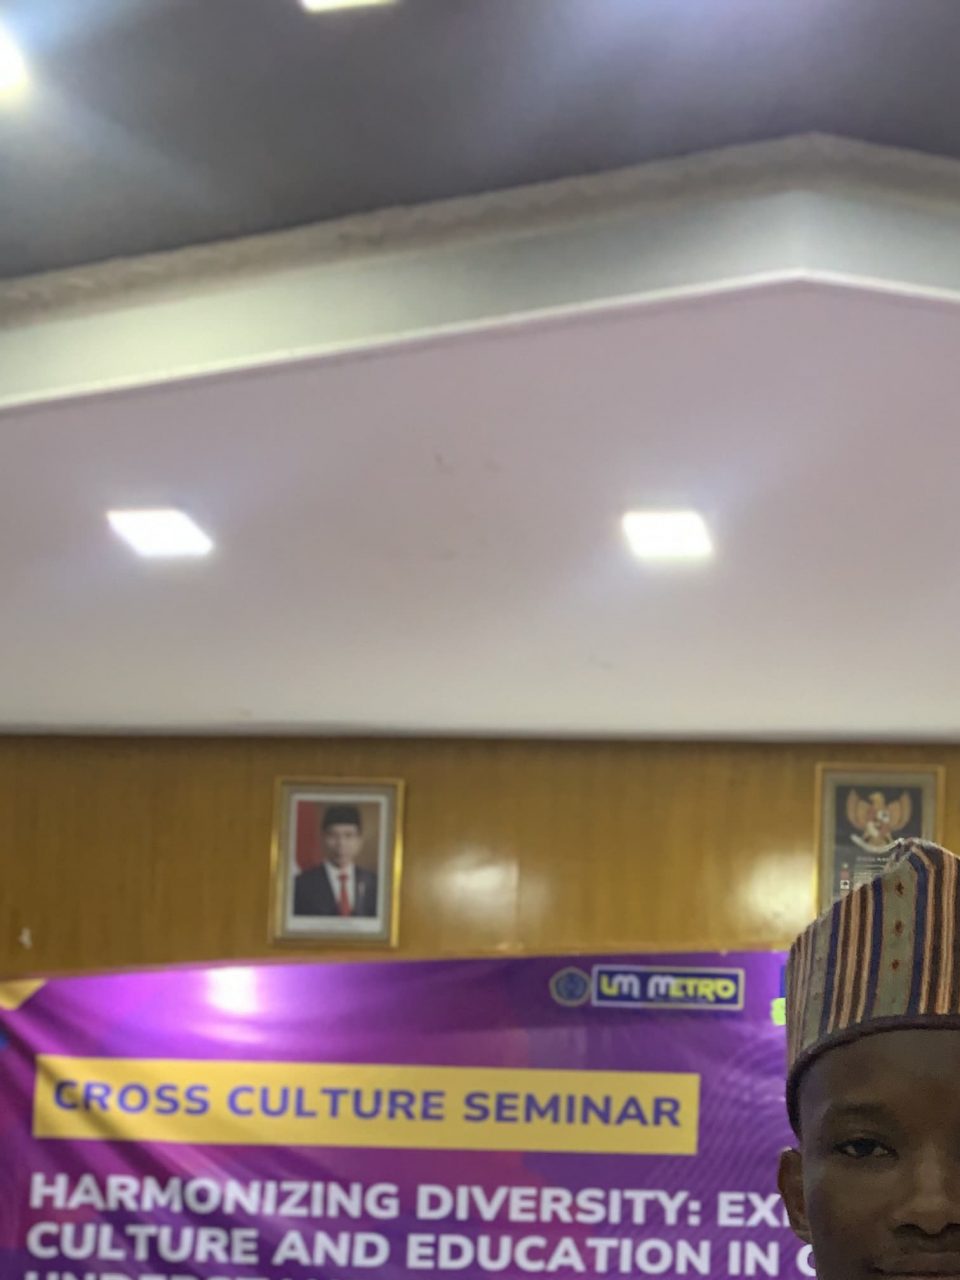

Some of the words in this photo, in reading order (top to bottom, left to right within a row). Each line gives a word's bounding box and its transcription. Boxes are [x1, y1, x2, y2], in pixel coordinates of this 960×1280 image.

[647, 975, 737, 1002] METRO
[53, 1080, 210, 1116] CROSS
[227, 1086, 445, 1121] CULTURE
[463, 1091, 681, 1127] SEMINAR
[29, 1172, 399, 1219] HARMONIZING
[416, 1183, 701, 1226] DIVERSITY:
[717, 1191, 792, 1228] EX
[26, 1221, 259, 1265] CULTURE
[272, 1230, 390, 1268] AND
[406, 1233, 711, 1275] EDUCATION
[727, 1240, 779, 1276] IN
